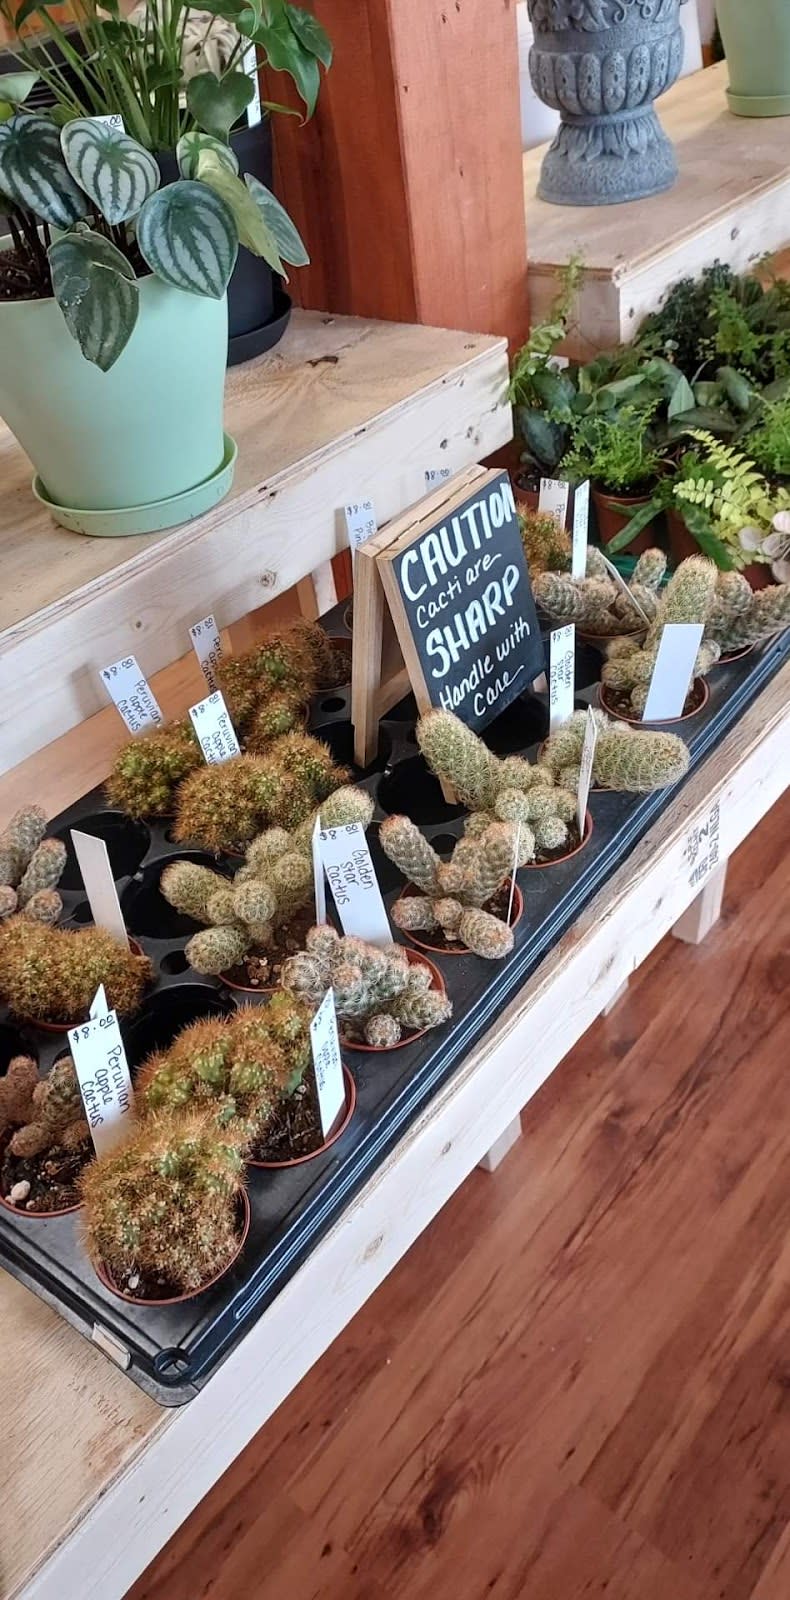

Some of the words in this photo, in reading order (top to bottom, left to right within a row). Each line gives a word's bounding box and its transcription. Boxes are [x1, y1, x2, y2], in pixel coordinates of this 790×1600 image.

[401, 483, 516, 601] CAUTION
[417, 576, 461, 628] Cacti
[466, 553, 502, 585] are
[426, 565, 519, 678] SHARP
[439, 655, 494, 712] Handle
[496, 616, 530, 661] with
[564, 650, 574, 688] Golden
[134, 680, 161, 724] Peruvian
[474, 665, 524, 716] Care
[217, 712, 238, 756] Peruvian
[327, 865, 350, 905] Cactus
[341, 861, 359, 886] Star
[352, 849, 374, 889] Golden
[95, 1069, 113, 1105] apple
[107, 1045, 131, 1114] Peruvian
[82, 1081, 104, 1128] Cactus
